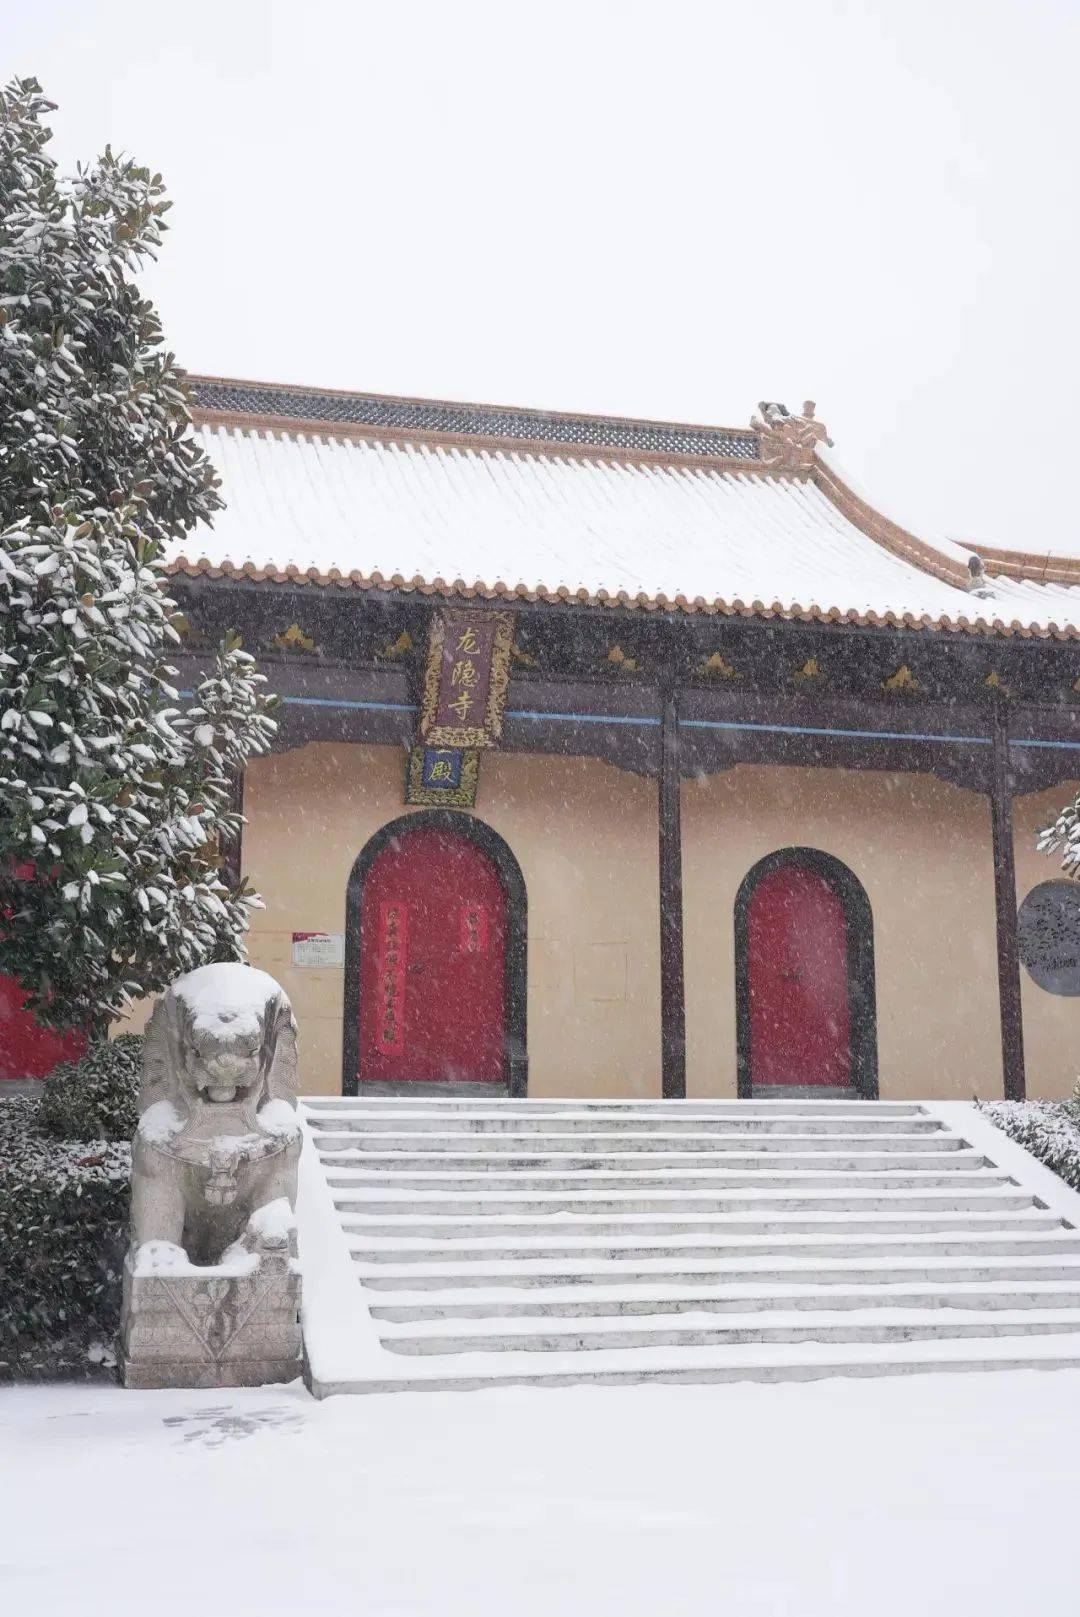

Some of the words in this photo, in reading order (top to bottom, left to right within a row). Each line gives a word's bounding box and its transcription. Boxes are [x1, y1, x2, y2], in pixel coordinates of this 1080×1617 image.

[448, 626, 481, 721] 龙隐寺
[427, 749, 456, 783] 殿
